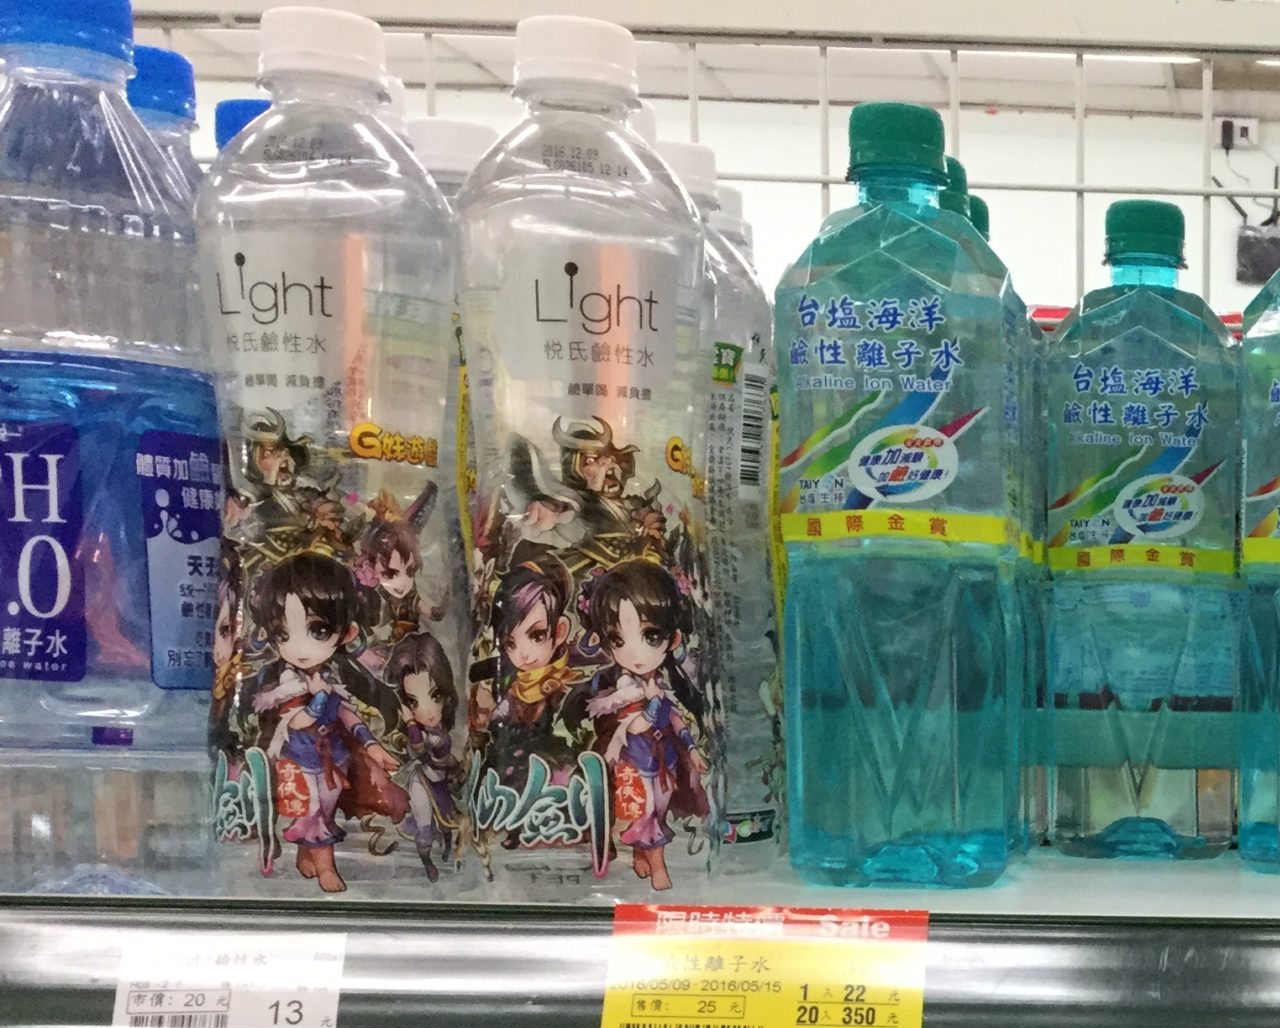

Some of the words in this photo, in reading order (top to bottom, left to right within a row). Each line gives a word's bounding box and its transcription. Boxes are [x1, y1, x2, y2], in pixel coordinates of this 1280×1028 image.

[217, 252, 333, 325] Light
[535, 262, 658, 335] Light
[544, 341, 655, 368] 悅氏鹼性水
[790, 337, 964, 370] 鹼性離子水
[864, 375, 892, 390] Ion
[901, 376, 951, 392] Water
[1063, 400, 1211, 428] 鹼性離子水
[1129, 433, 1153, 446] Ion
[1159, 433, 1200, 447] Water
[0, 452, 67, 522] H
[807, 514, 948, 537] 國際金賞
[818, 914, 890, 938] Sale
[667, 954, 771, 973] 性離子水
[183, 993, 205, 1008] 20
[800, 985, 809, 1002] 1
[844, 985, 866, 1002] 22
[268, 1000, 304, 1026] 13
[697, 1001, 717, 1013] 25
[796, 1006, 818, 1024] 20
[842, 1007, 876, 1025] 350
